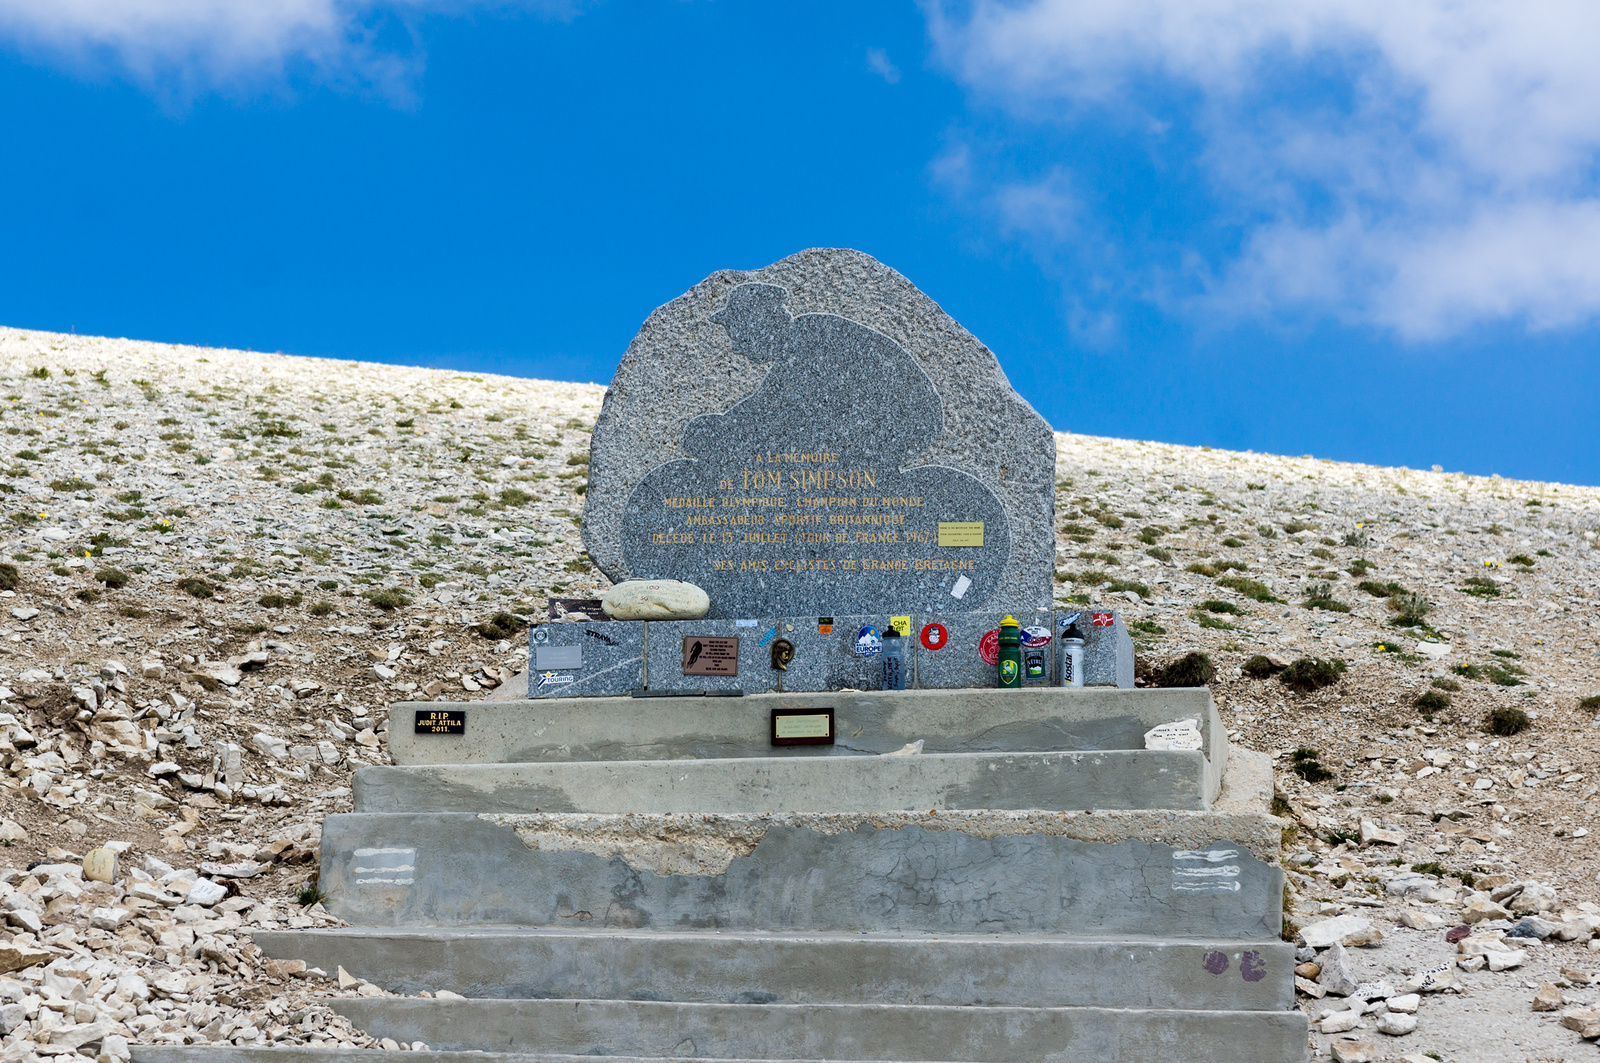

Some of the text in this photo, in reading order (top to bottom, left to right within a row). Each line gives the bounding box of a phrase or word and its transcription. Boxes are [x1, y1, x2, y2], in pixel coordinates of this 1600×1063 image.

[755, 452, 839, 463] A LA MEMOIRE
[720, 470, 876, 490] DE TOM SIMPSON
[664, 497, 715, 508] MEDAILLE
[797, 497, 857, 507] CHAMPION
[862, 497, 878, 506] DU
[882, 497, 924, 507] MONDE
[686, 515, 905, 525] AMBASSADEUR SPORTIF BRITANNIQUE
[653, 533, 694, 543] DECEDE
[703, 533, 716, 543] LE
[722, 532, 734, 543] 13
[741, 533, 788, 543] JUILLET
[795, 531, 831, 544] (TOUR
[836, 533, 849, 543] DE
[855, 531, 900, 543] FRANCE
[714, 559, 976, 570] SES AMIS CYCLISTES DE GRANDE BRETAGNE
[585, 629, 611, 643] STRAVA
[856, 645, 881, 653] EUROPE
[430, 712, 449, 720] R.I.P.
